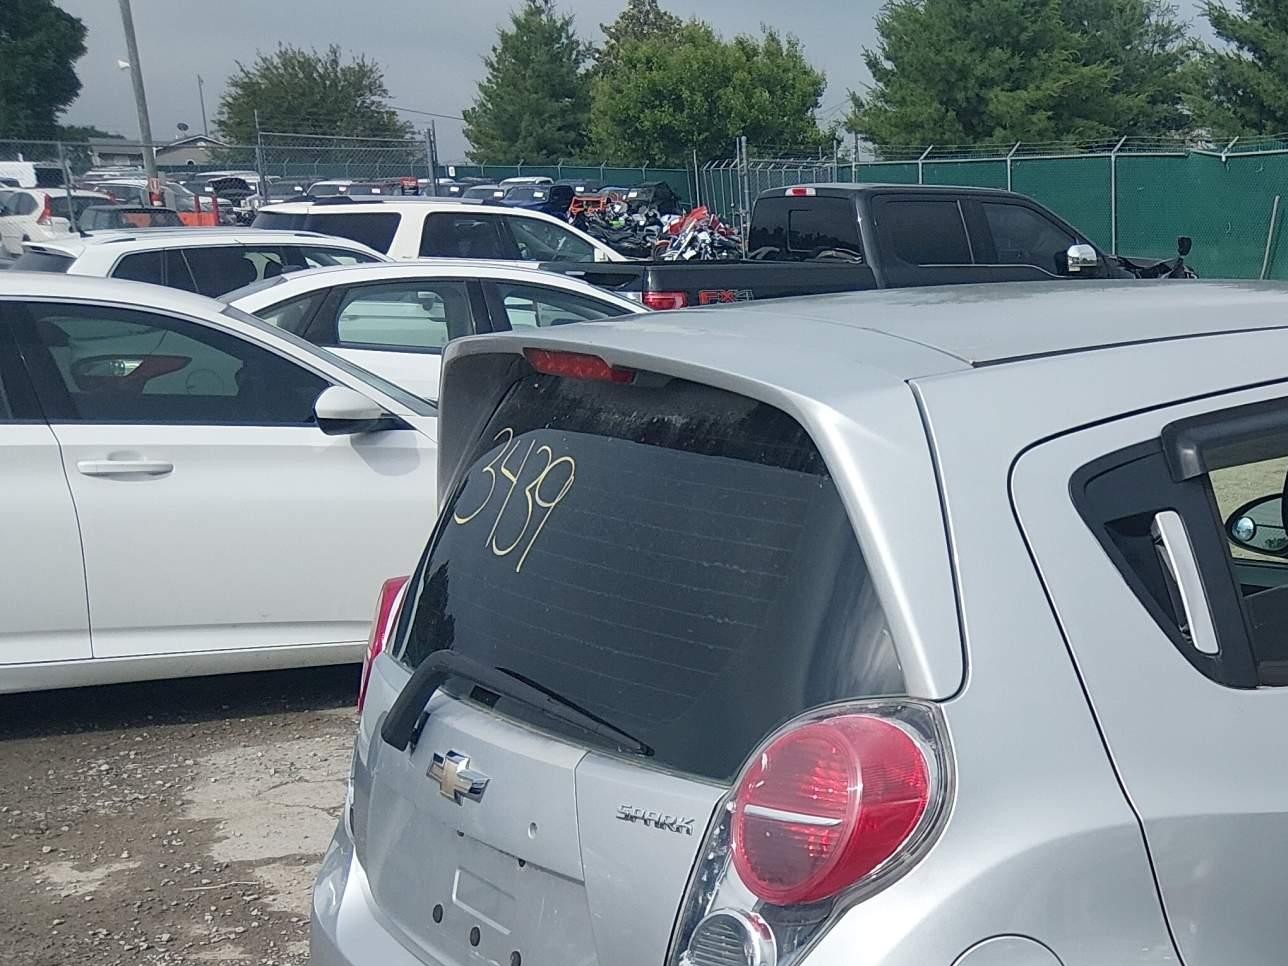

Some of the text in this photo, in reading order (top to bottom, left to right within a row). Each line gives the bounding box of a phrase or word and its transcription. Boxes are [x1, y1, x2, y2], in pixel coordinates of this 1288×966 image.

[698, 289, 754, 304] FX4
[453, 427, 575, 573] 3439
[615, 804, 696, 836] SPARK
